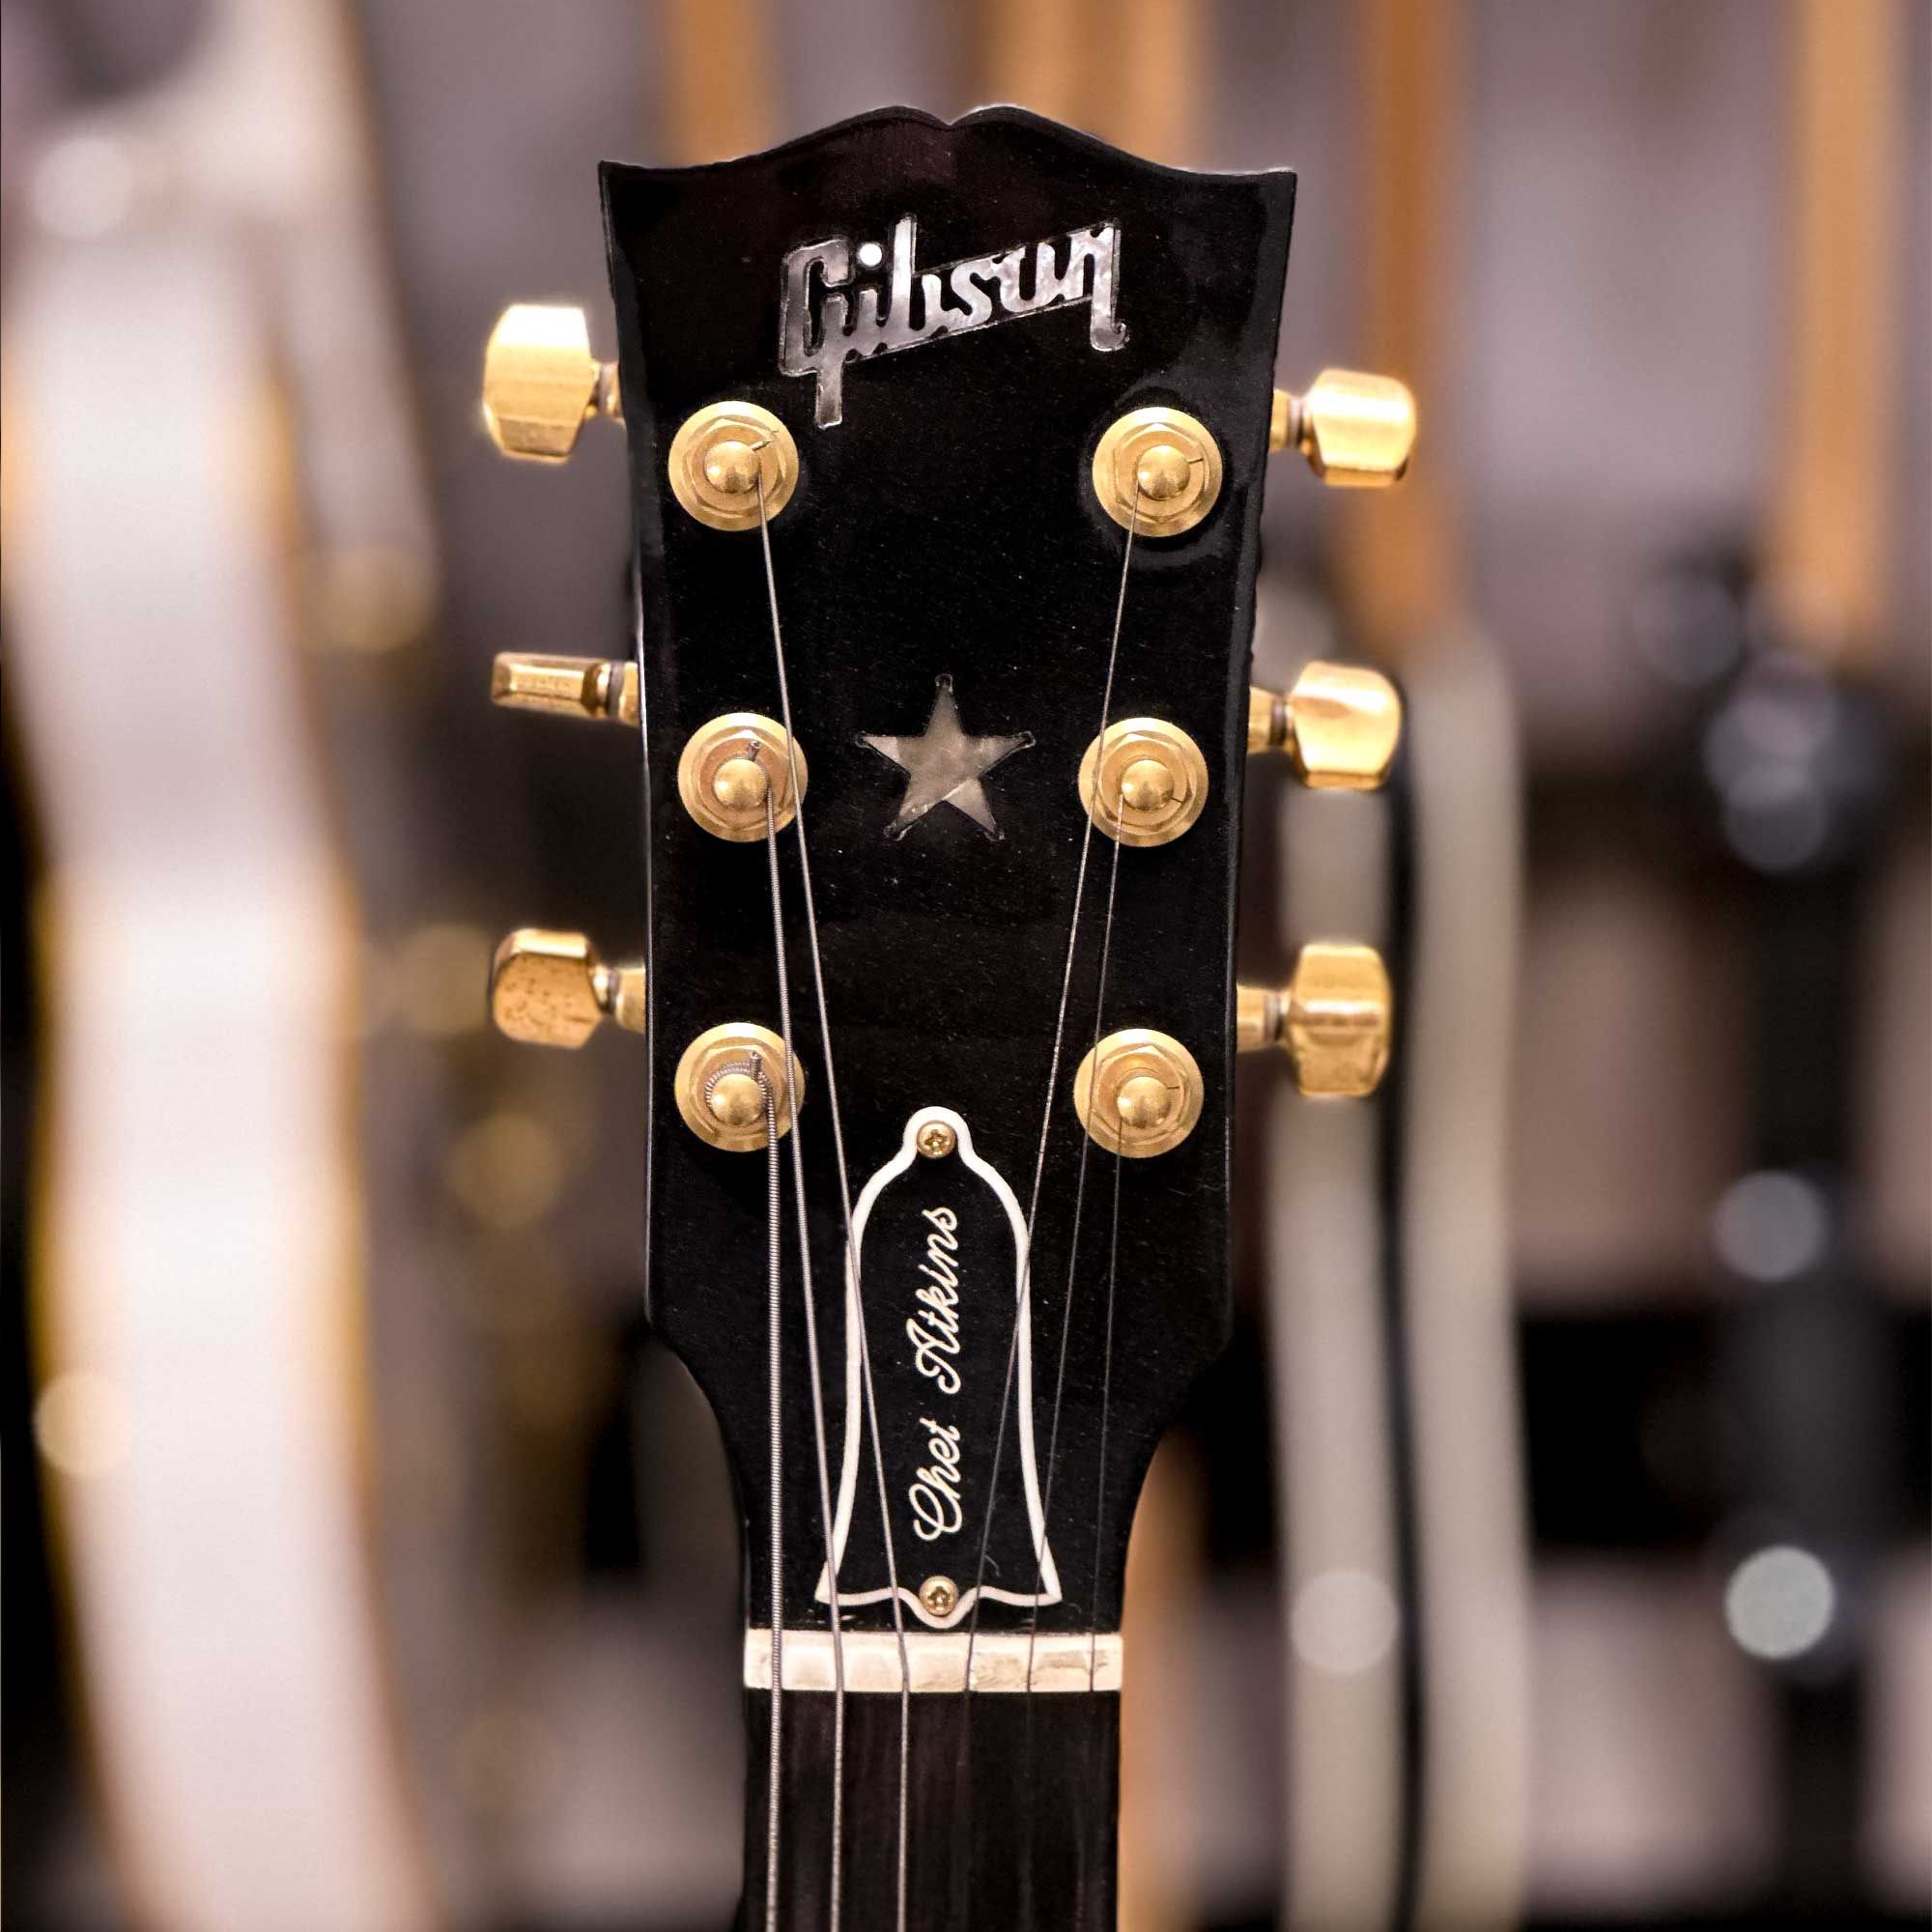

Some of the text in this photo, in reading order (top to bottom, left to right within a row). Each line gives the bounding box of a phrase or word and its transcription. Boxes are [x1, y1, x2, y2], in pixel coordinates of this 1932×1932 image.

[779, 213, 1129, 429] Gibson
[906, 1207, 962, 1541] Chet Atkins
